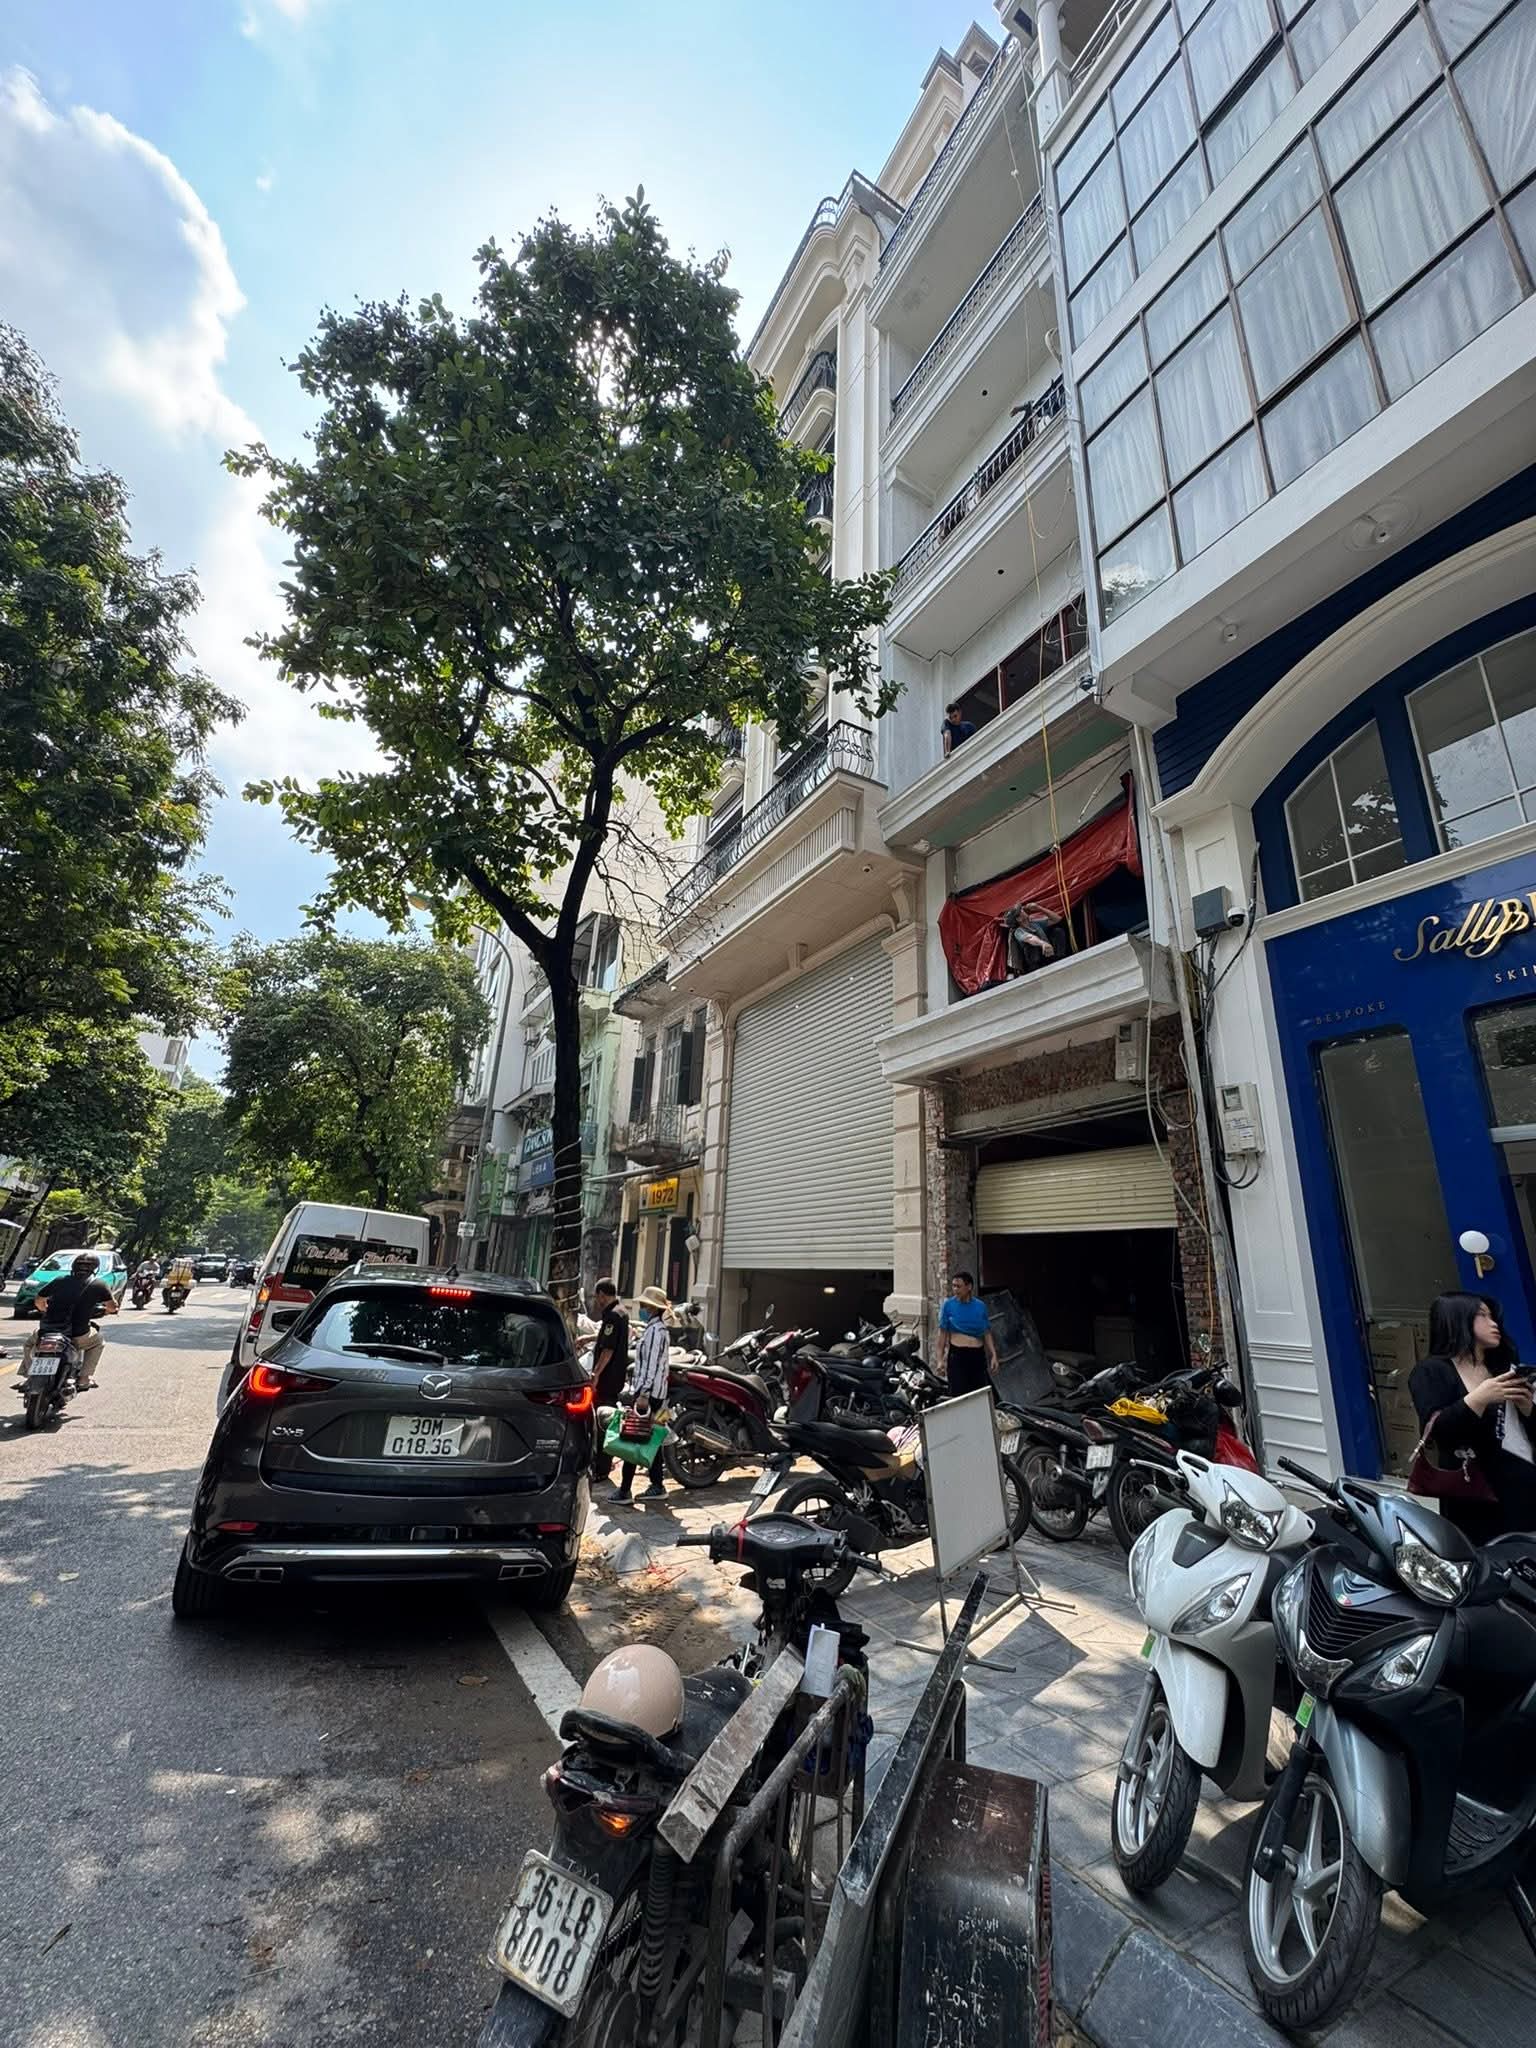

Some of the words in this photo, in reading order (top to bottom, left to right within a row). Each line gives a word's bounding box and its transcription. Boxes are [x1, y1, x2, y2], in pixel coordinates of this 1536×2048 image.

[1315, 1000, 1386, 1025] BESPOKE
[651, 1187, 674, 1205] 1972
[272, 1426, 305, 1437] CX-5
[410, 1418, 443, 1436] 30M
[392, 1437, 453, 1455] 018.36
[504, 1917, 578, 1995] 8008
